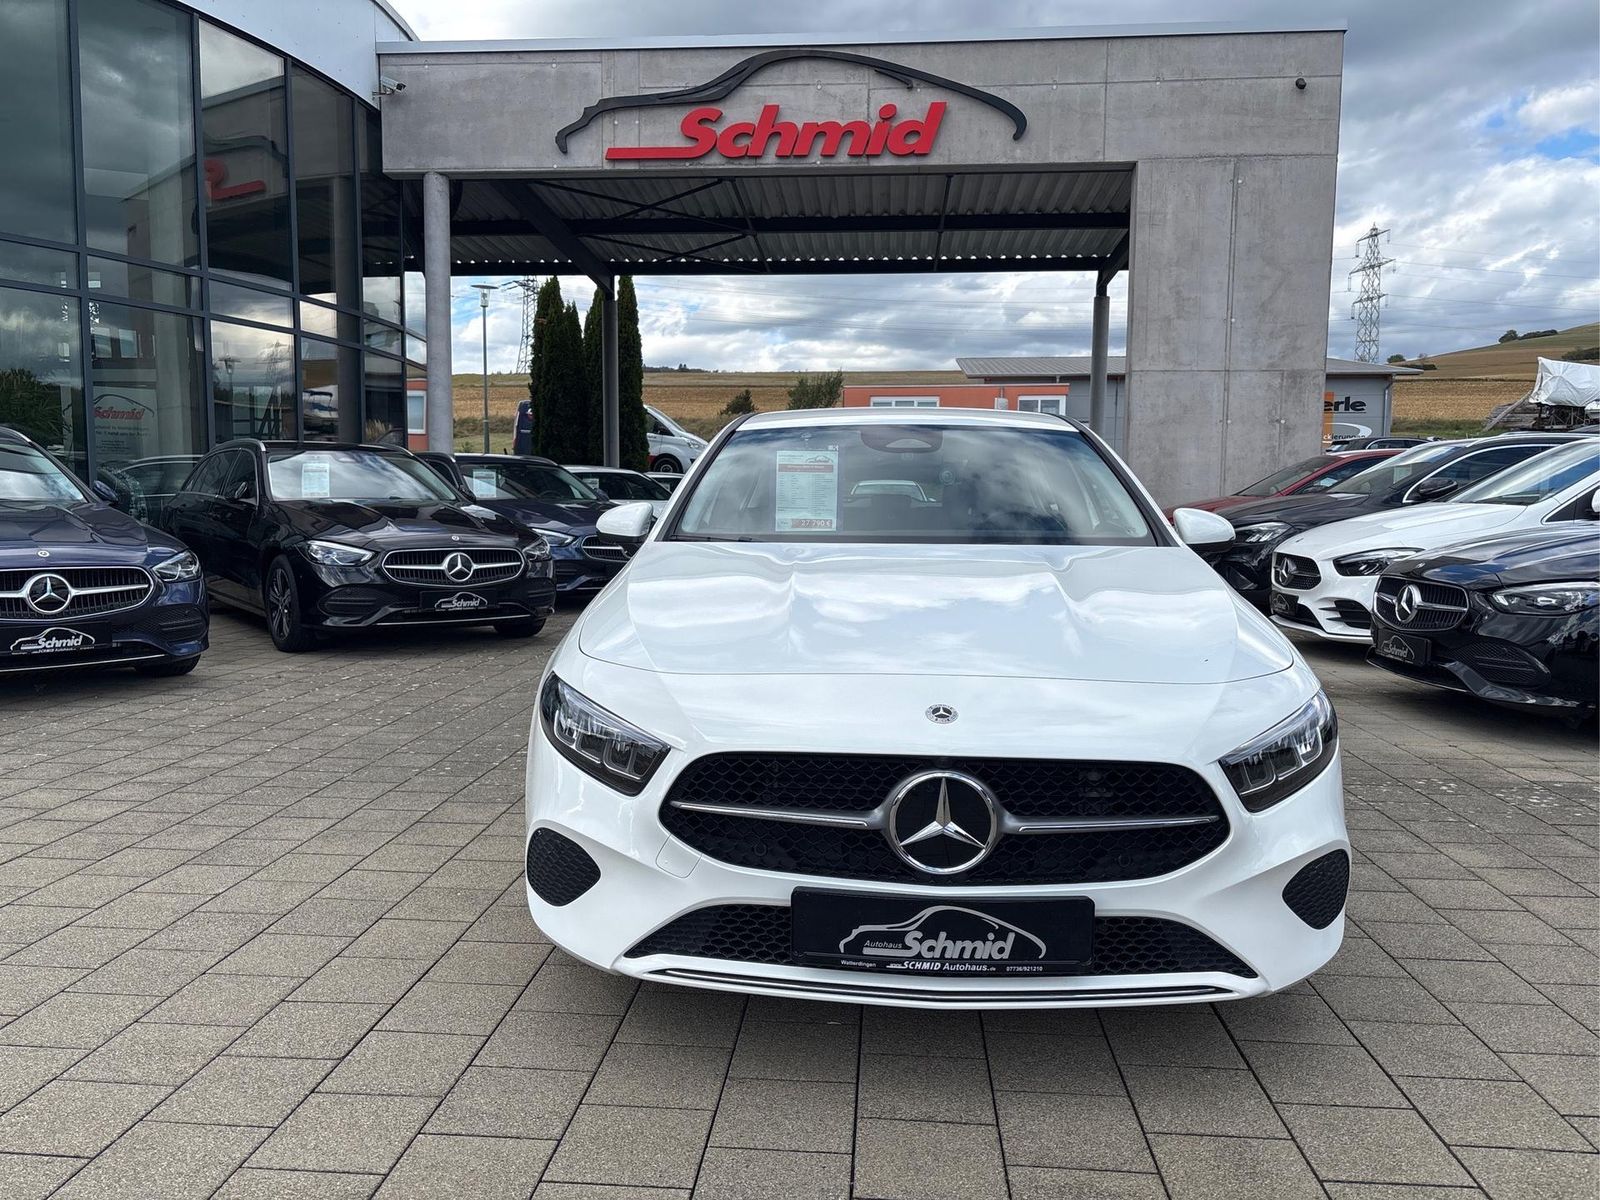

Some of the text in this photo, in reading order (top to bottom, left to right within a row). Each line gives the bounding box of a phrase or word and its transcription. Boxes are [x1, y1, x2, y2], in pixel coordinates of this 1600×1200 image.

[605, 101, 948, 160] Schmid
[441, 599, 480, 608] Schmid
[21, 635, 83, 649] Schmid
[863, 939, 902, 949] Autohaus
[863, 930, 1016, 959] Schmid
